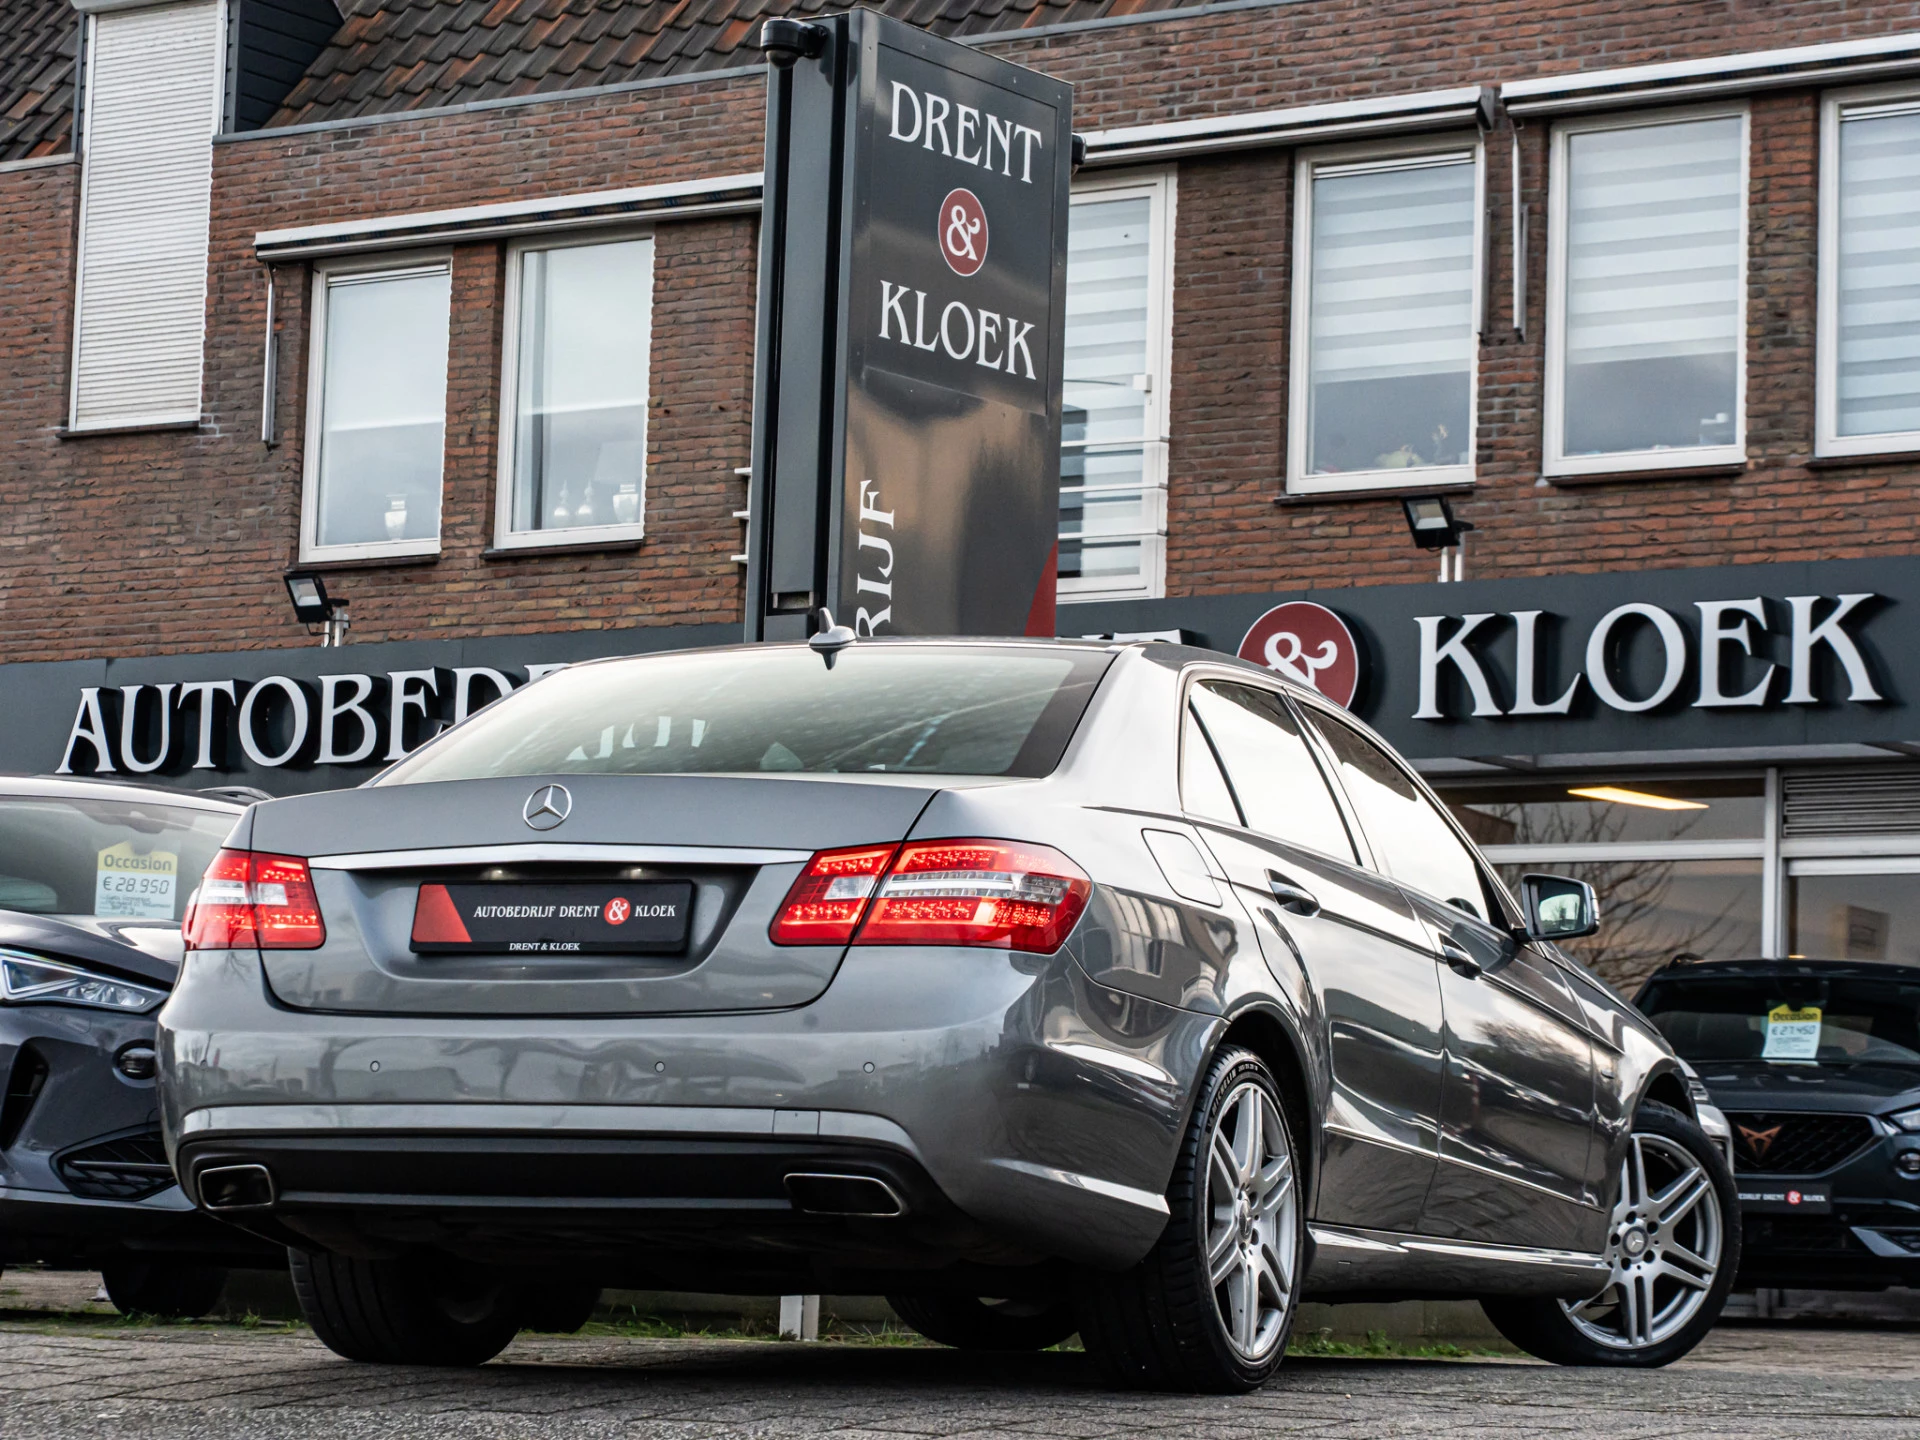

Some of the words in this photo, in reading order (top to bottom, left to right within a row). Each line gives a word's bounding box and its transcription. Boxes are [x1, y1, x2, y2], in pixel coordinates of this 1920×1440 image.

[889, 80, 1042, 184] DRENT
[946, 204, 981, 262] &
[878, 279, 1037, 381] KLOEK
[1411, 592, 1883, 720] KLOEK
[104, 855, 171, 871] Occasion
[103, 876, 113, 891] €
[115, 877, 169, 894] 28.950
[473, 905, 556, 918] AUTOBEDRIJF
[559, 905, 600, 918] DRENT
[608, 900, 628, 921] &
[635, 904, 676, 917] KLOEK
[509, 942, 540, 951] DRENT
[541, 942, 548, 951] &
[550, 942, 580, 951] KLOEK
